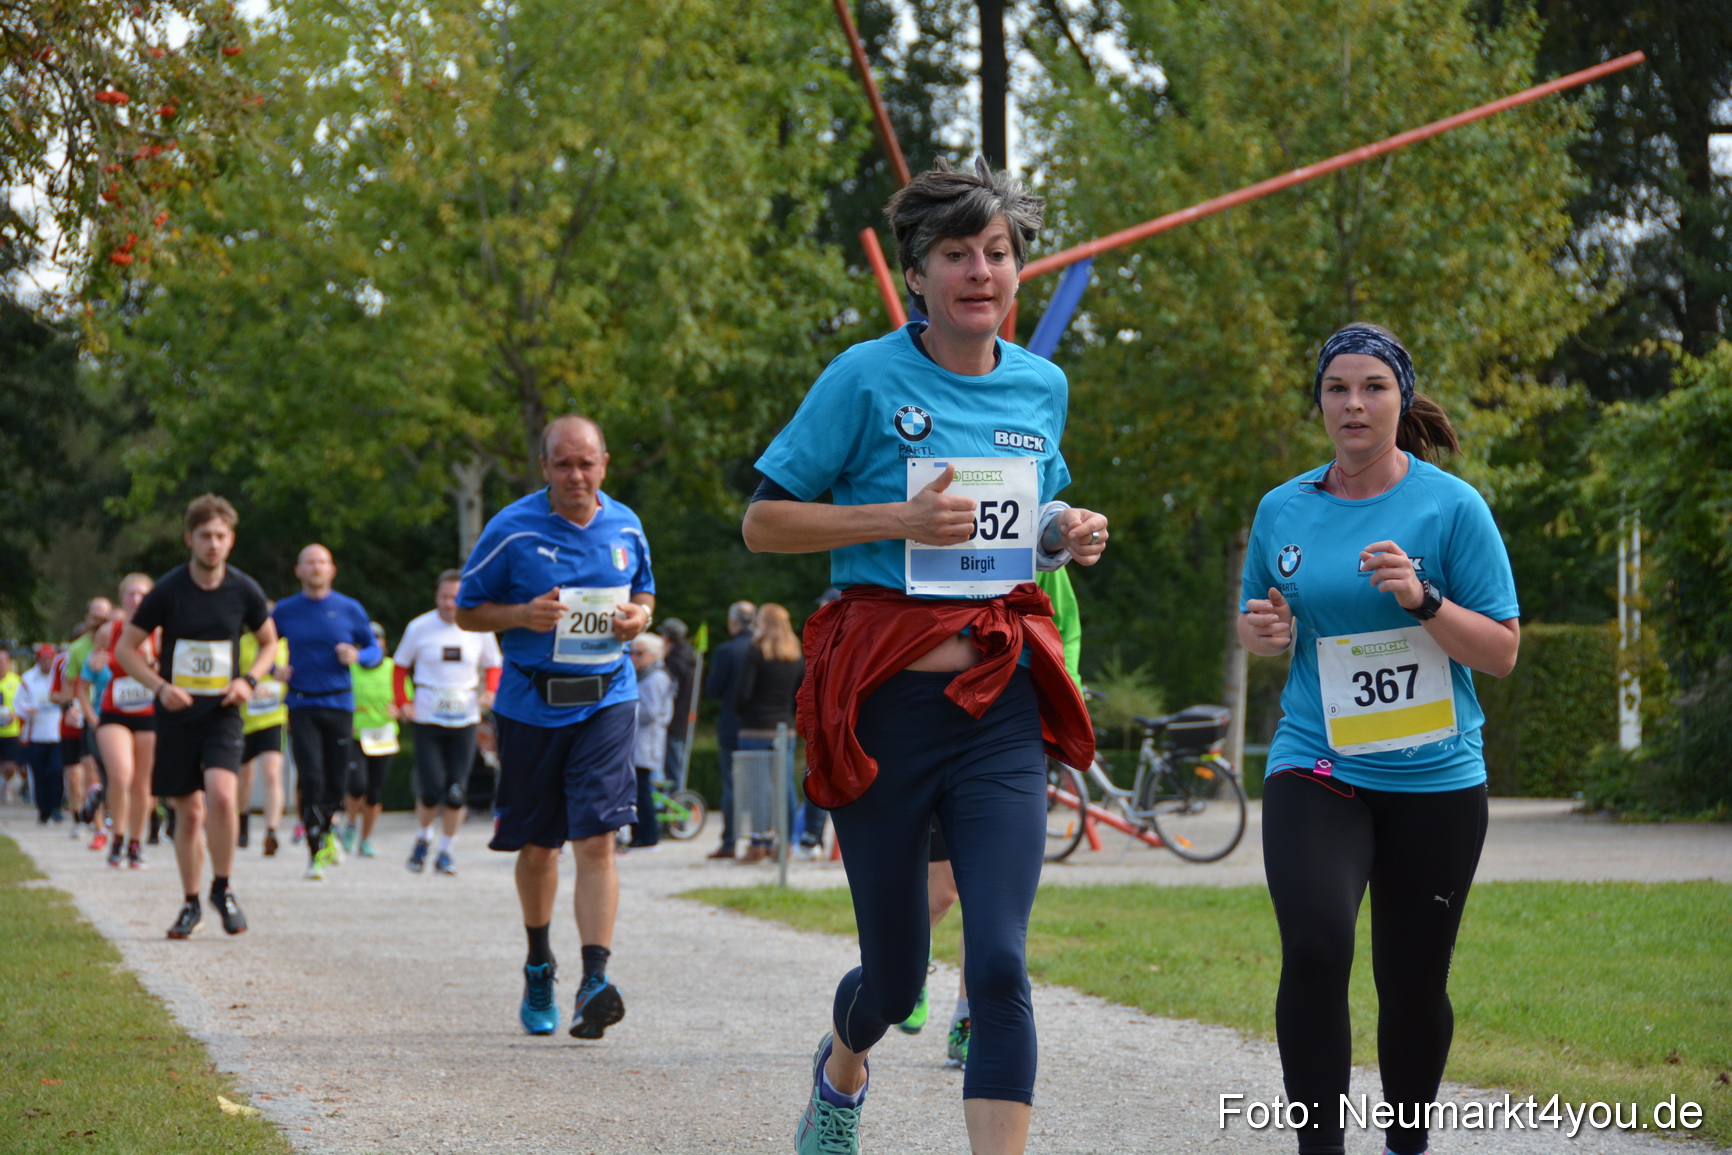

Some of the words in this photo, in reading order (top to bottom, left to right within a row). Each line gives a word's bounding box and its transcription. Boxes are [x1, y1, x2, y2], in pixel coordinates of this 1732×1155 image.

[898, 443, 936, 456] PARTL
[994, 430, 1047, 453] BOCK
[962, 470, 1004, 482] BOCK
[960, 556, 996, 573] Birgit
[1364, 639, 1410, 655] BOCK
[192, 656, 214, 674] 30
[1351, 663, 1419, 707] 367
